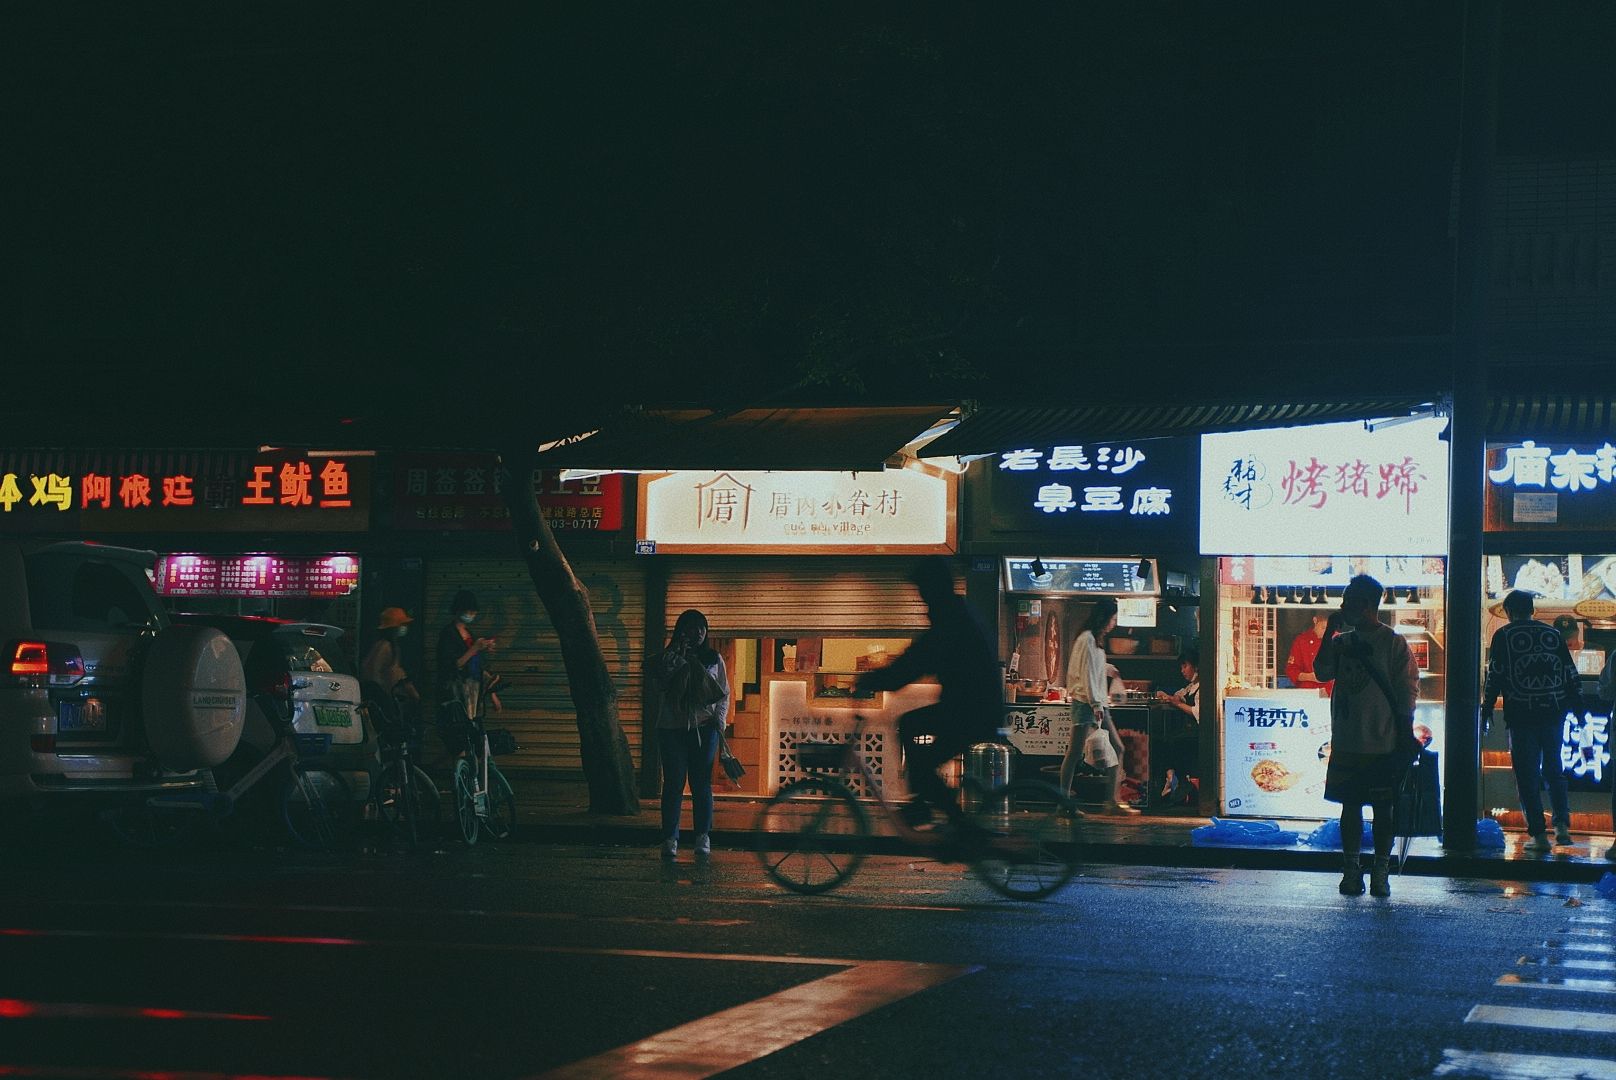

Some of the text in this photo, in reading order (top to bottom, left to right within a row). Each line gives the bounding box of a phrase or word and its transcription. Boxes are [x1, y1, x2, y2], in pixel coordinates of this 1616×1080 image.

[1034, 483, 1172, 515] 臭豆腐
[1281, 457, 1428, 515] 烤猪蹄
